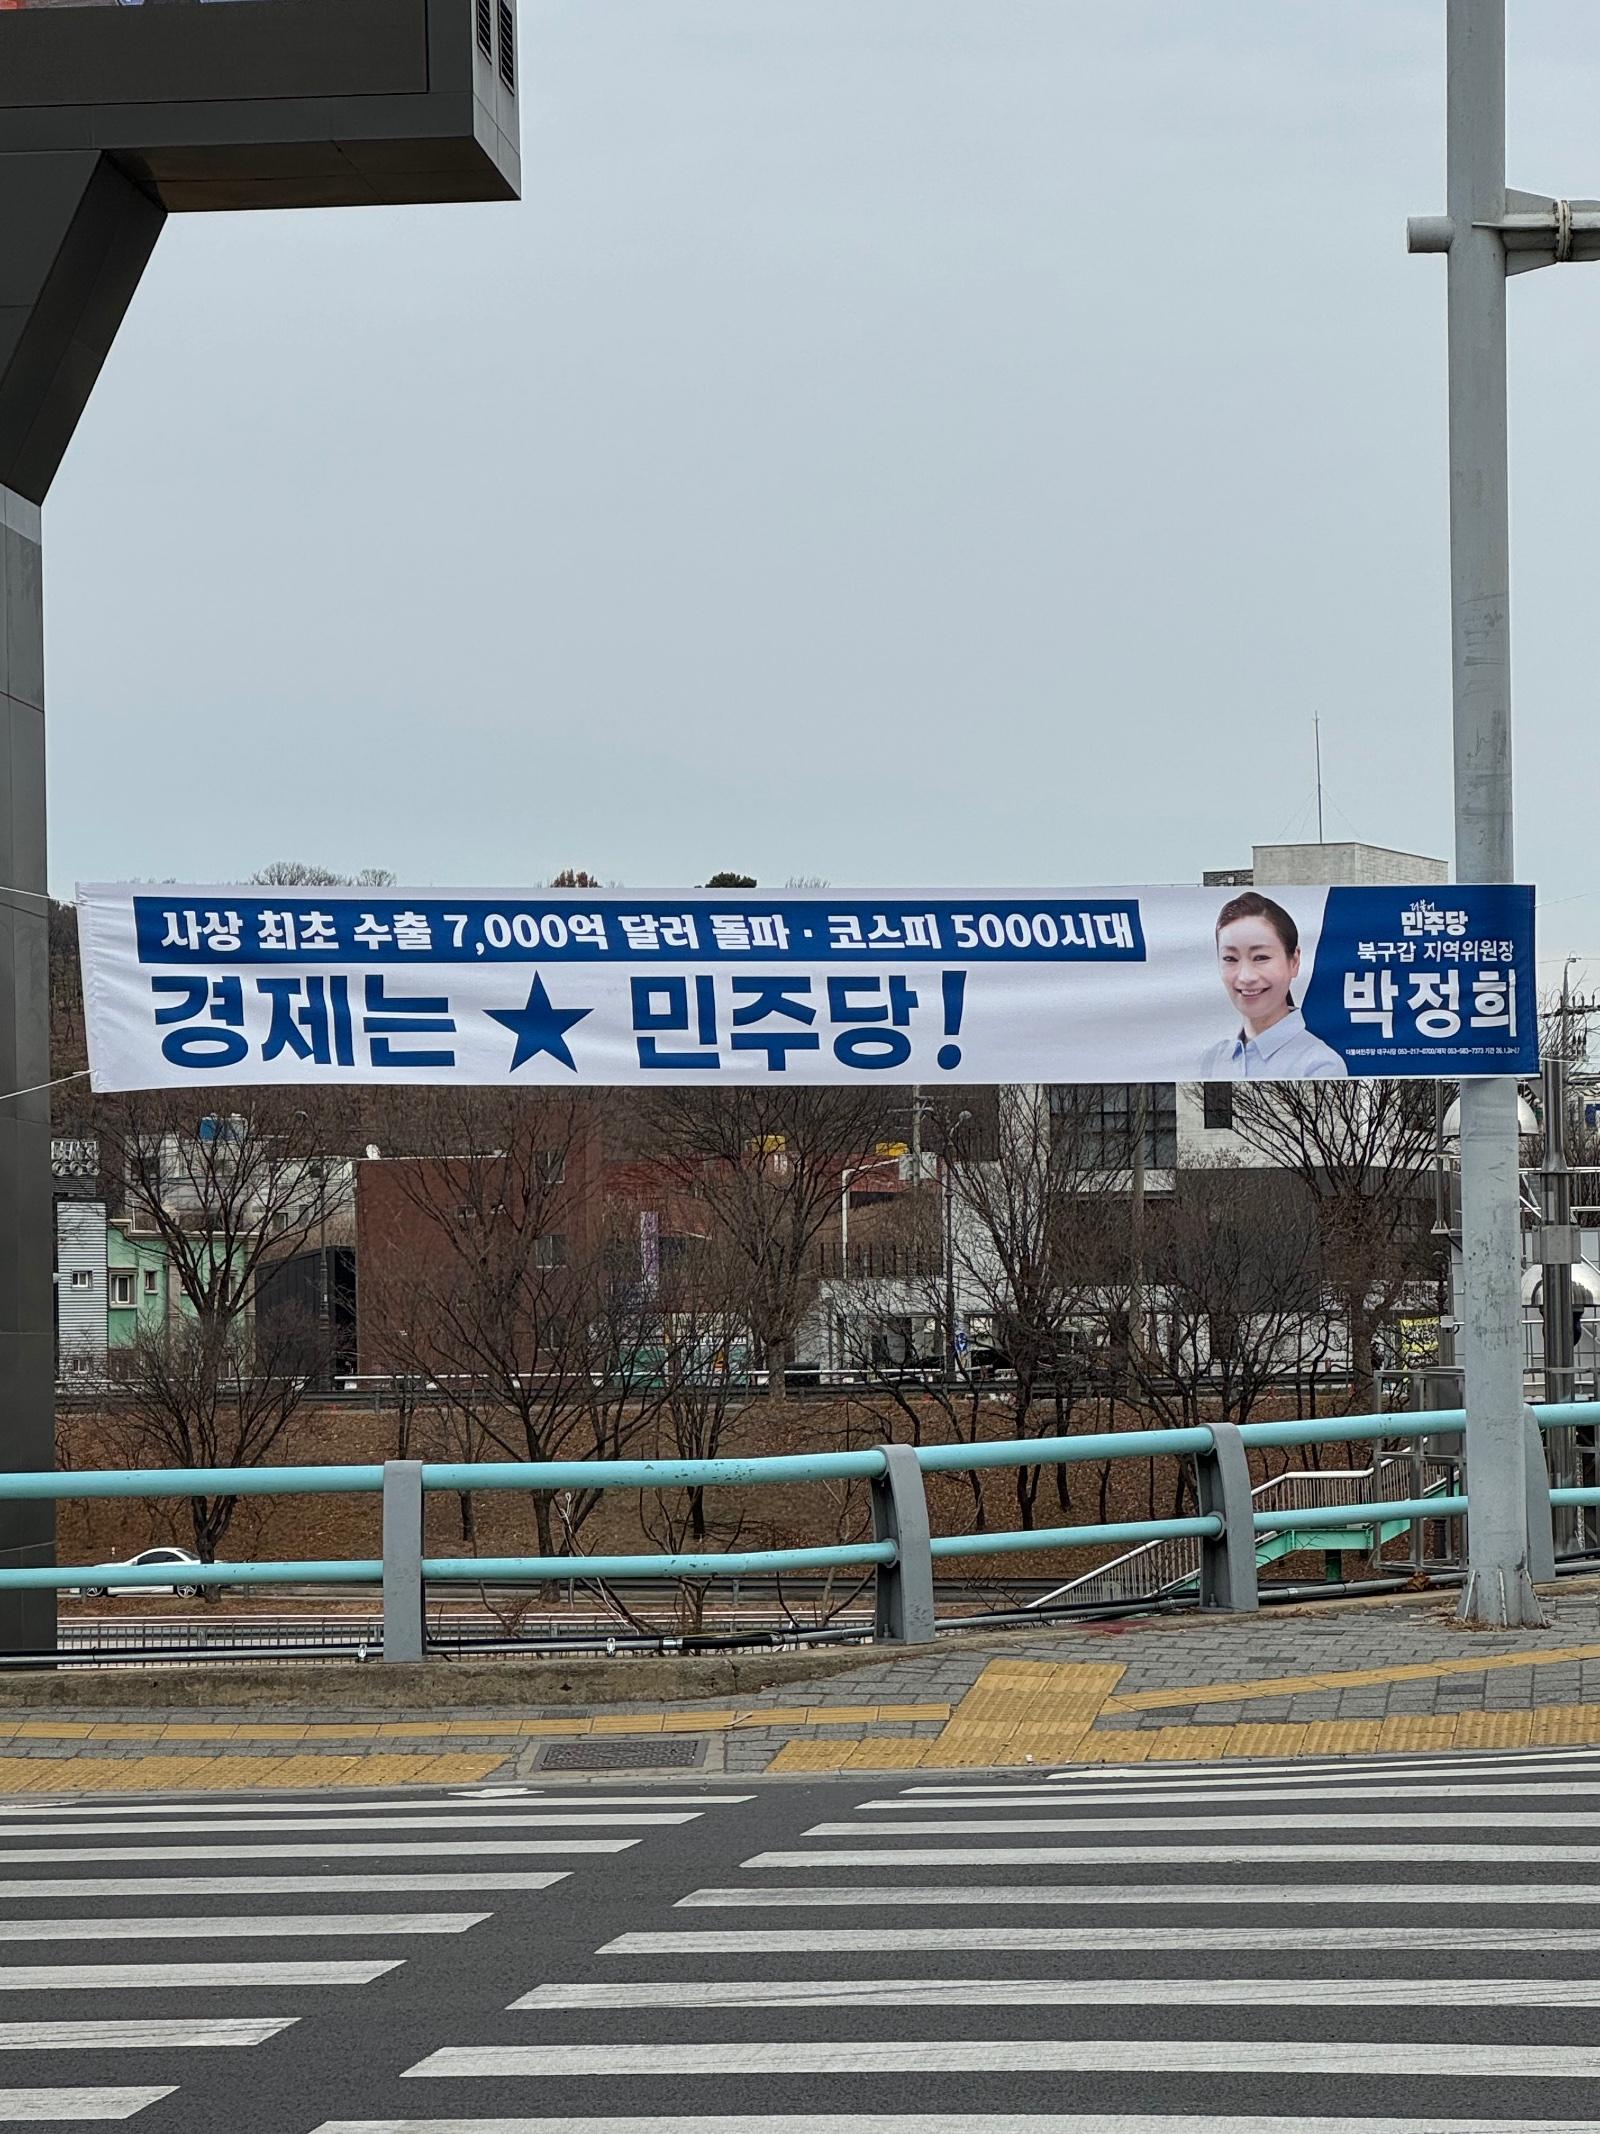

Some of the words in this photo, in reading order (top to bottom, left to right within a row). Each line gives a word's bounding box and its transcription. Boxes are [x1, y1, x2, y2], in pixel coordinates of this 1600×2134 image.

[1410, 899, 1434, 911] 더불어
[162, 911, 243, 951] 사상
[258, 911, 339, 950] 최초
[354, 912, 432, 949] 수출
[444, 914, 608, 955] 7,000억
[618, 915, 699, 949] 달러
[710, 915, 789, 949] 돌파
[828, 914, 941, 949] 코스피
[951, 913, 1133, 948] 5000시대
[1401, 910, 1468, 936] 민주당
[1358, 941, 1416, 962] 북구갑
[1424, 940, 1513, 962] 지역위원장
[152, 975, 456, 1068] 경제는
[631, 971, 966, 1071] 민주당!
[1344, 969, 1516, 1038] 박정희
